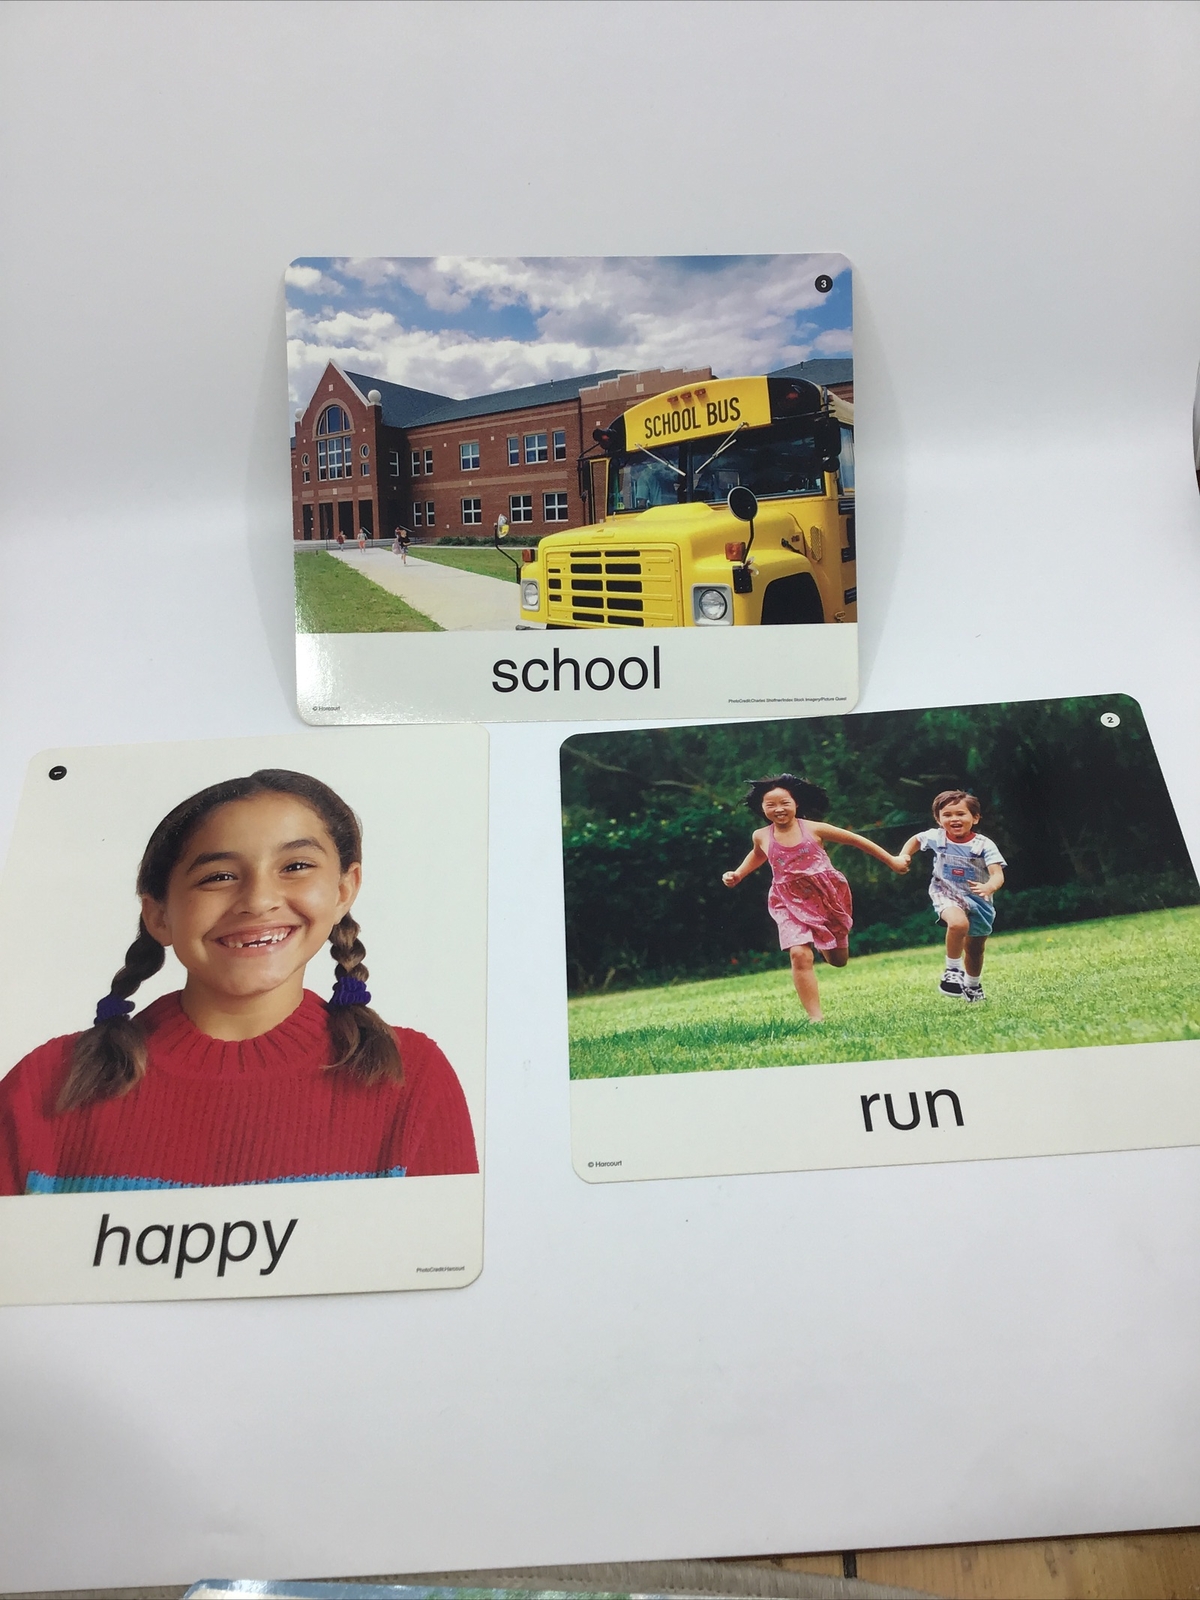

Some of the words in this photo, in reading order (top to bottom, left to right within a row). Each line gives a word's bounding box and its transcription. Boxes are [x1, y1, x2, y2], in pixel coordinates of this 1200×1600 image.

[820, 279, 827, 289] 3
[644, 406, 701, 439] SCHOOL
[706, 396, 741, 427] BUS
[492, 645, 661, 693] school
[1106, 716, 1115, 724] 2
[860, 1088, 965, 1132] run
[595, 1160, 623, 1168] Harcourt
[92, 1213, 299, 1279] happy
